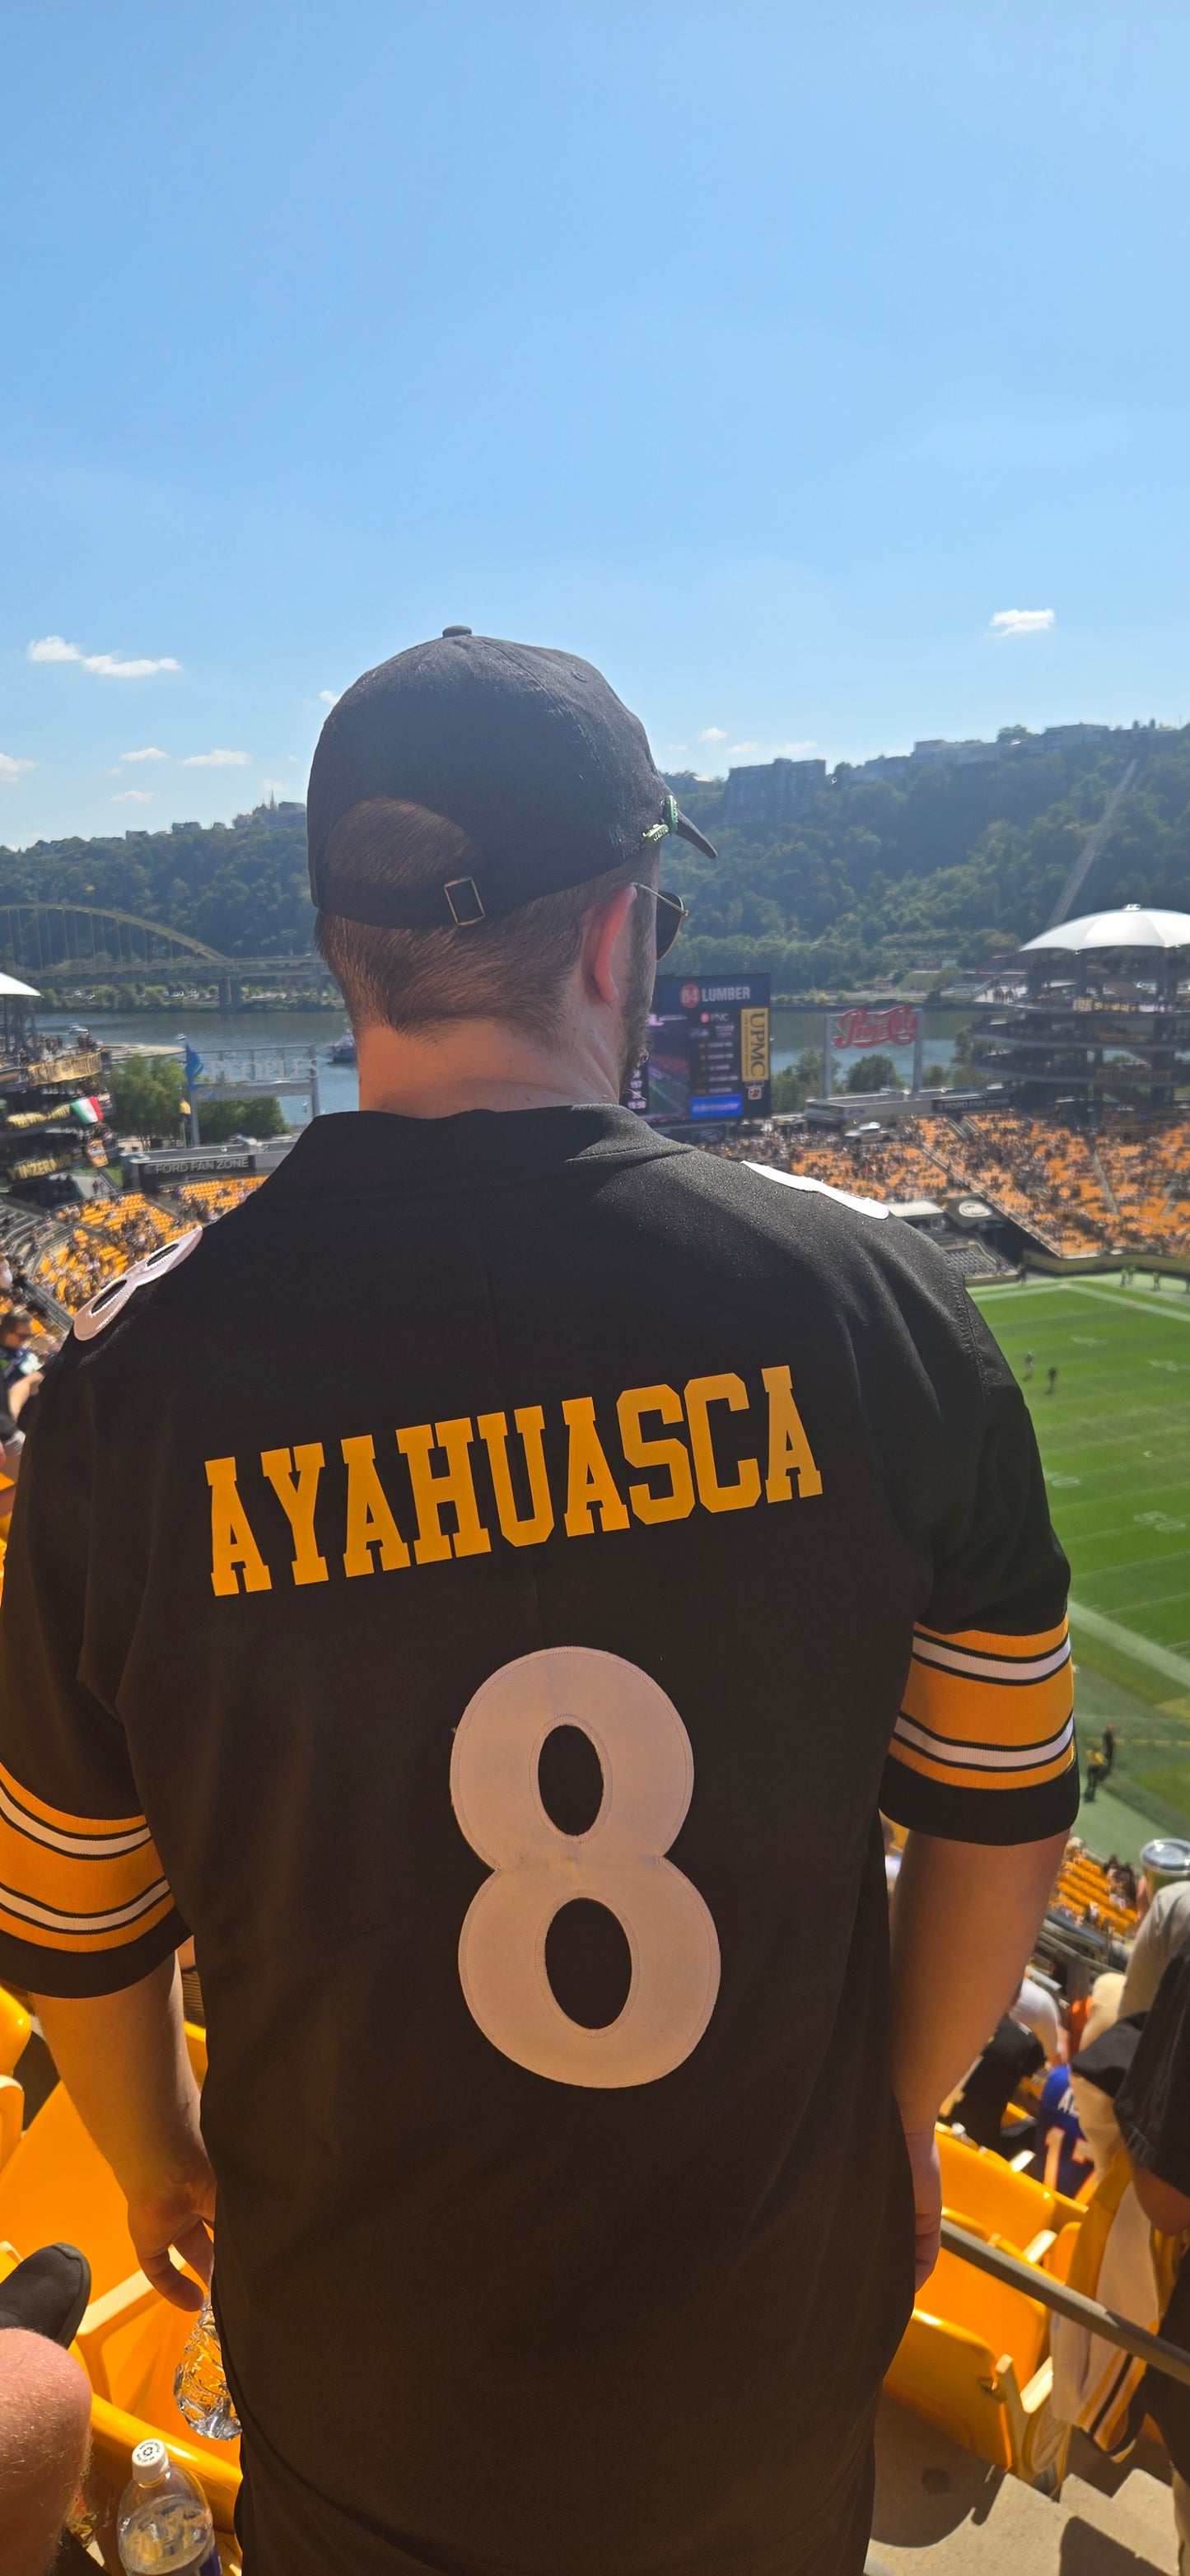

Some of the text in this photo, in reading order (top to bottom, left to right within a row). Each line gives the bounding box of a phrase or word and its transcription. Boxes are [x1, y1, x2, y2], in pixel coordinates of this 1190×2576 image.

[702, 987, 751, 1002] LUMBER
[749, 1012, 766, 1077] UPMC
[210, 1057, 320, 1082] PEOPLES
[945, 1102, 968, 1110] FORD
[968, 1099, 986, 1108] FAN
[156, 1156, 249, 1174] FORD FAN ZONE
[73, 1225, 203, 1342] 8
[205, 1365, 822, 1596] AYAHUASCA
[450, 1646, 721, 2088] 8
